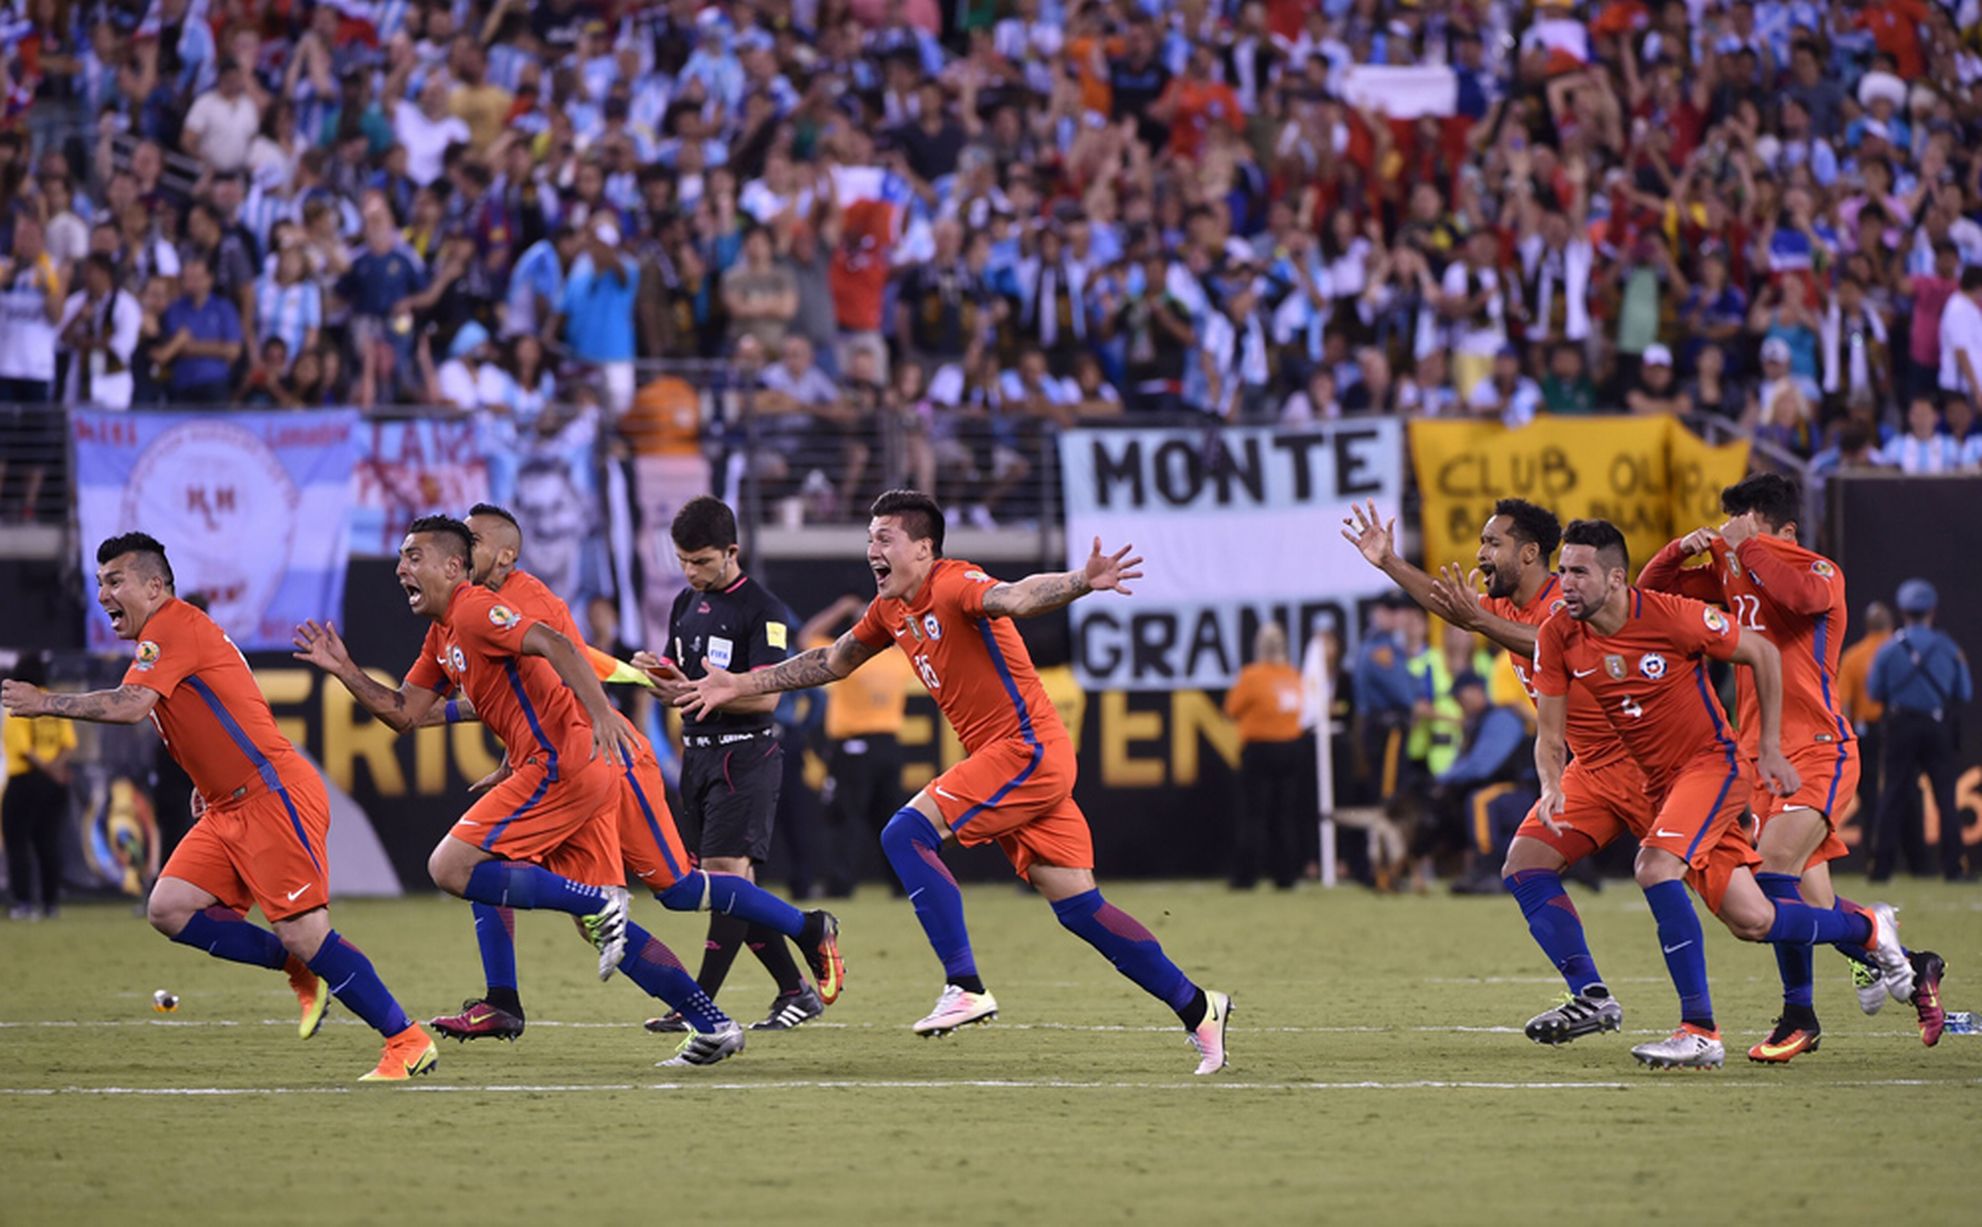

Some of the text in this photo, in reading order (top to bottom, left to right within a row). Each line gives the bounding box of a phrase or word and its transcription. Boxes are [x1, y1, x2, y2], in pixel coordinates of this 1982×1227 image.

[1093, 430, 1383, 507] MONTE
[1437, 447, 1578, 499] CLUB
[1078, 599, 1386, 681] GRAND
